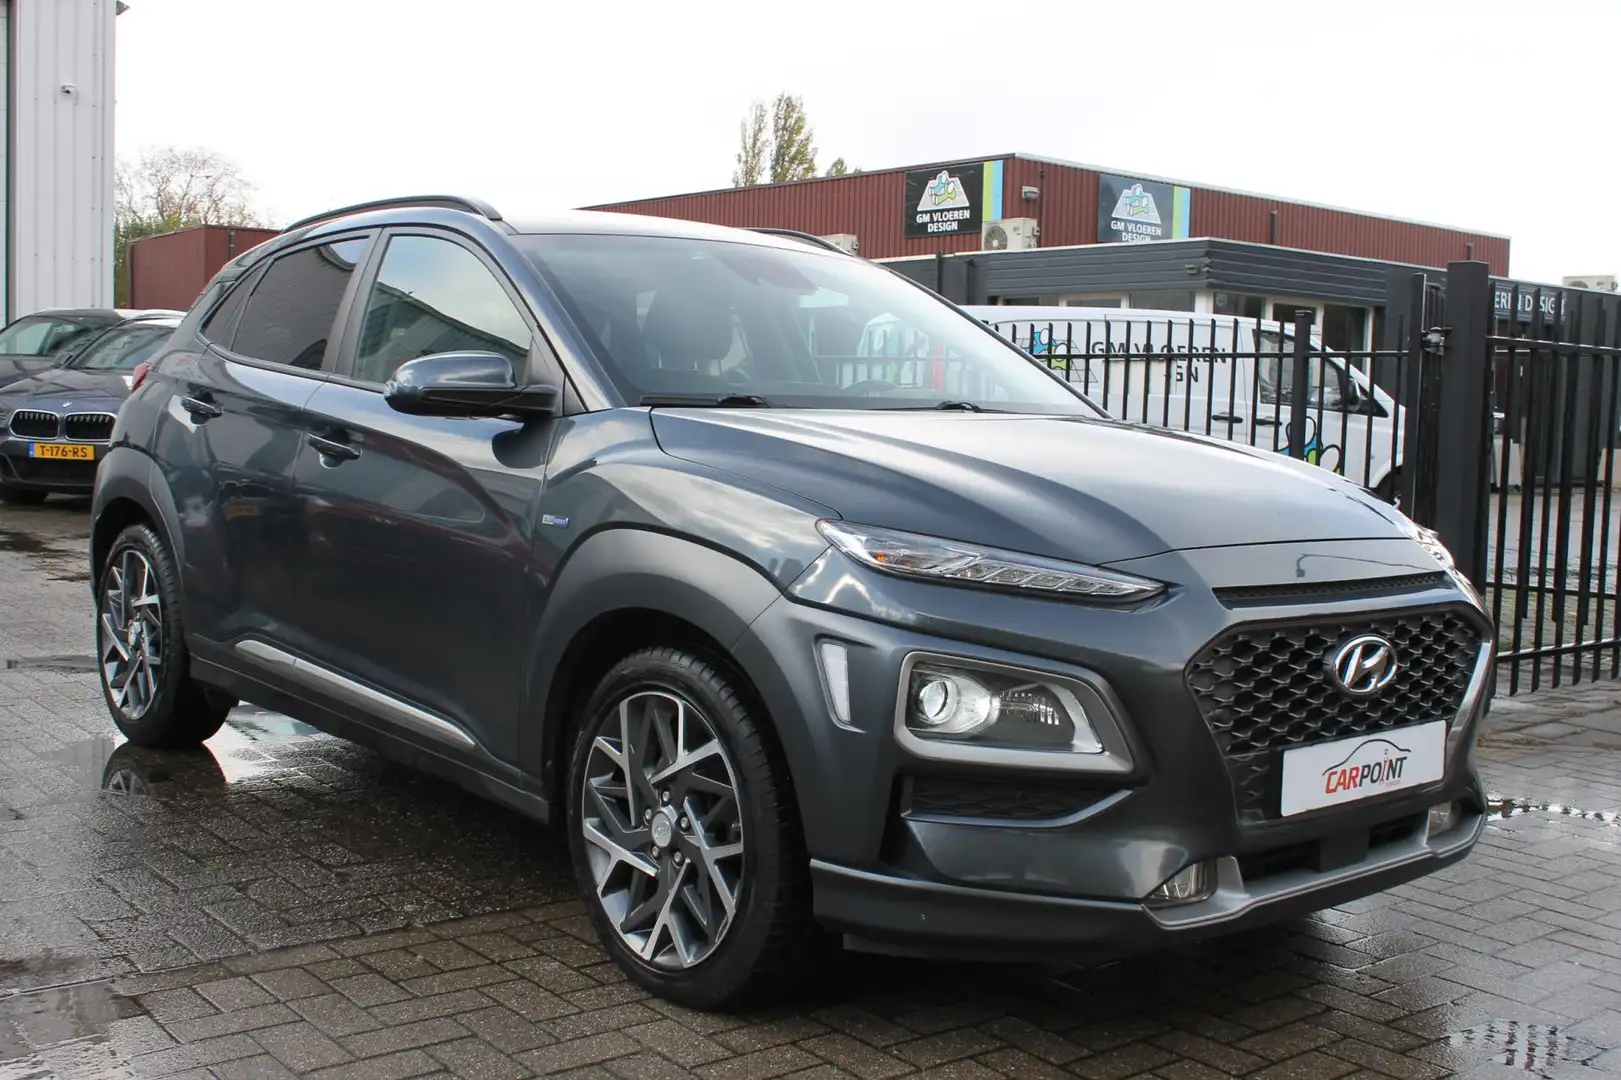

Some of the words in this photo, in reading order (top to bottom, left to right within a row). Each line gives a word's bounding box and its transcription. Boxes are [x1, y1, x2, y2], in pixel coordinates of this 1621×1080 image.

[916, 213, 930, 223] GM
[933, 209, 970, 222] VLOEREN
[928, 221, 958, 232] DESIGN
[1111, 220, 1125, 231] GM
[1127, 222, 1162, 237] VLOEREN
[40, 445, 88, 458] T-176-RS
[1325, 756, 1408, 794] CARPOINT
